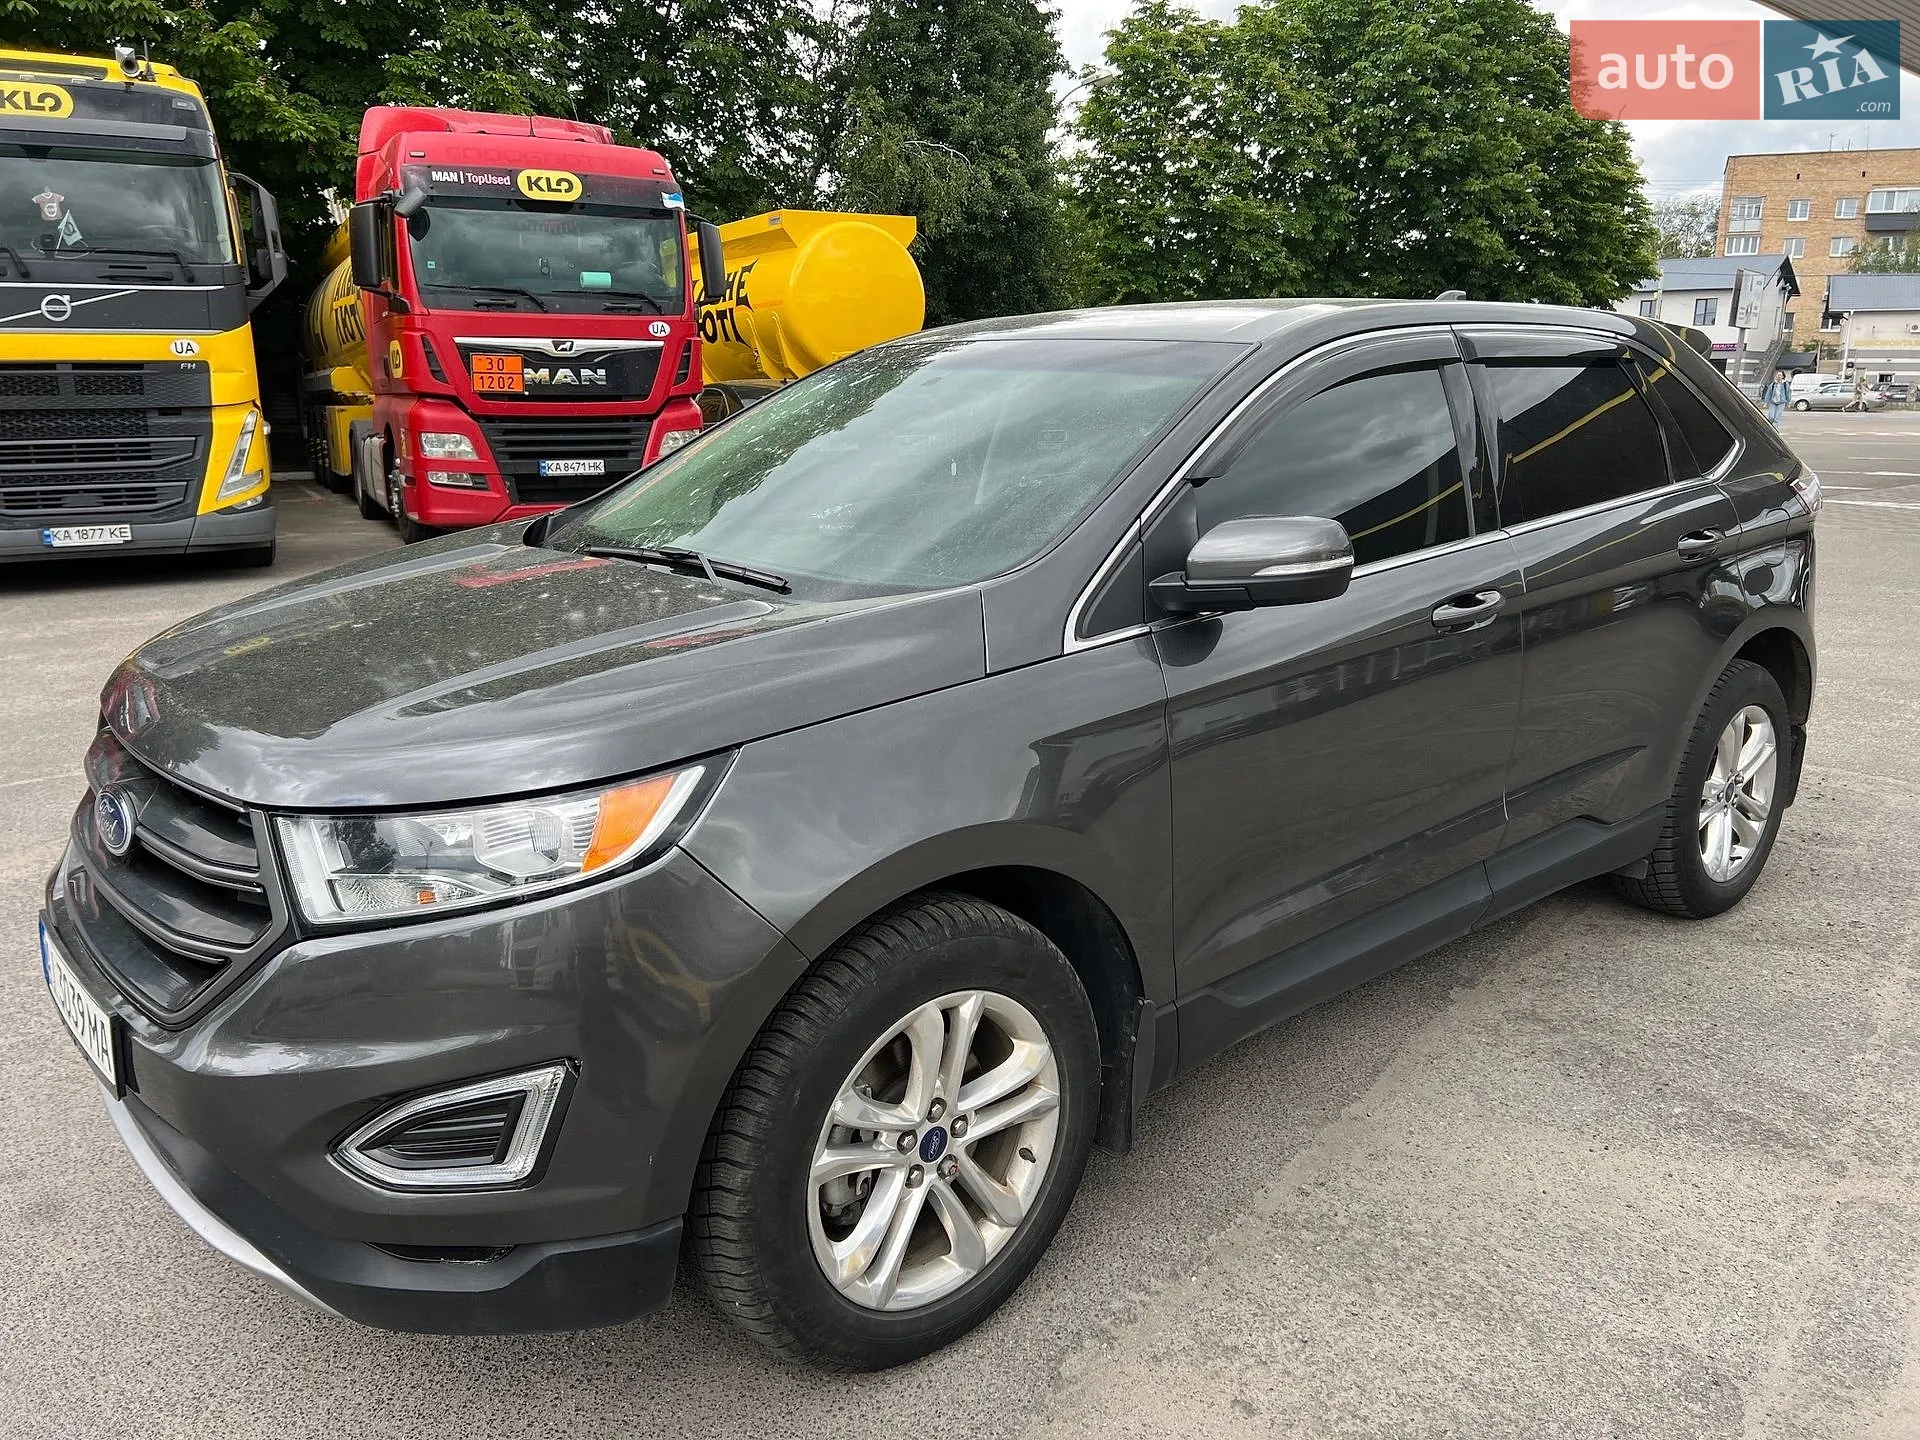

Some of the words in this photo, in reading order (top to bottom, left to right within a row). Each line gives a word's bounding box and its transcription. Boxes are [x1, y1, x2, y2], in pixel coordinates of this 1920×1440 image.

[0, 89, 63, 112] KLO
[431, 171, 458, 183] MAN
[466, 172, 511, 186] TopUsed
[526, 175, 574, 194] KLO
[652, 324, 667, 335] UA
[174, 341, 195, 354] UA
[485, 357, 505, 371] 30
[480, 375, 515, 390] 1202
[523, 368, 607, 385] MAN
[547, 462, 562, 473] KA
[563, 462, 586, 472] 8471
[588, 461, 603, 472] HK
[52, 529, 72, 541] KA
[74, 527, 104, 540] 1877
[108, 526, 129, 538] KE
[86, 1002, 112, 1072] MA
